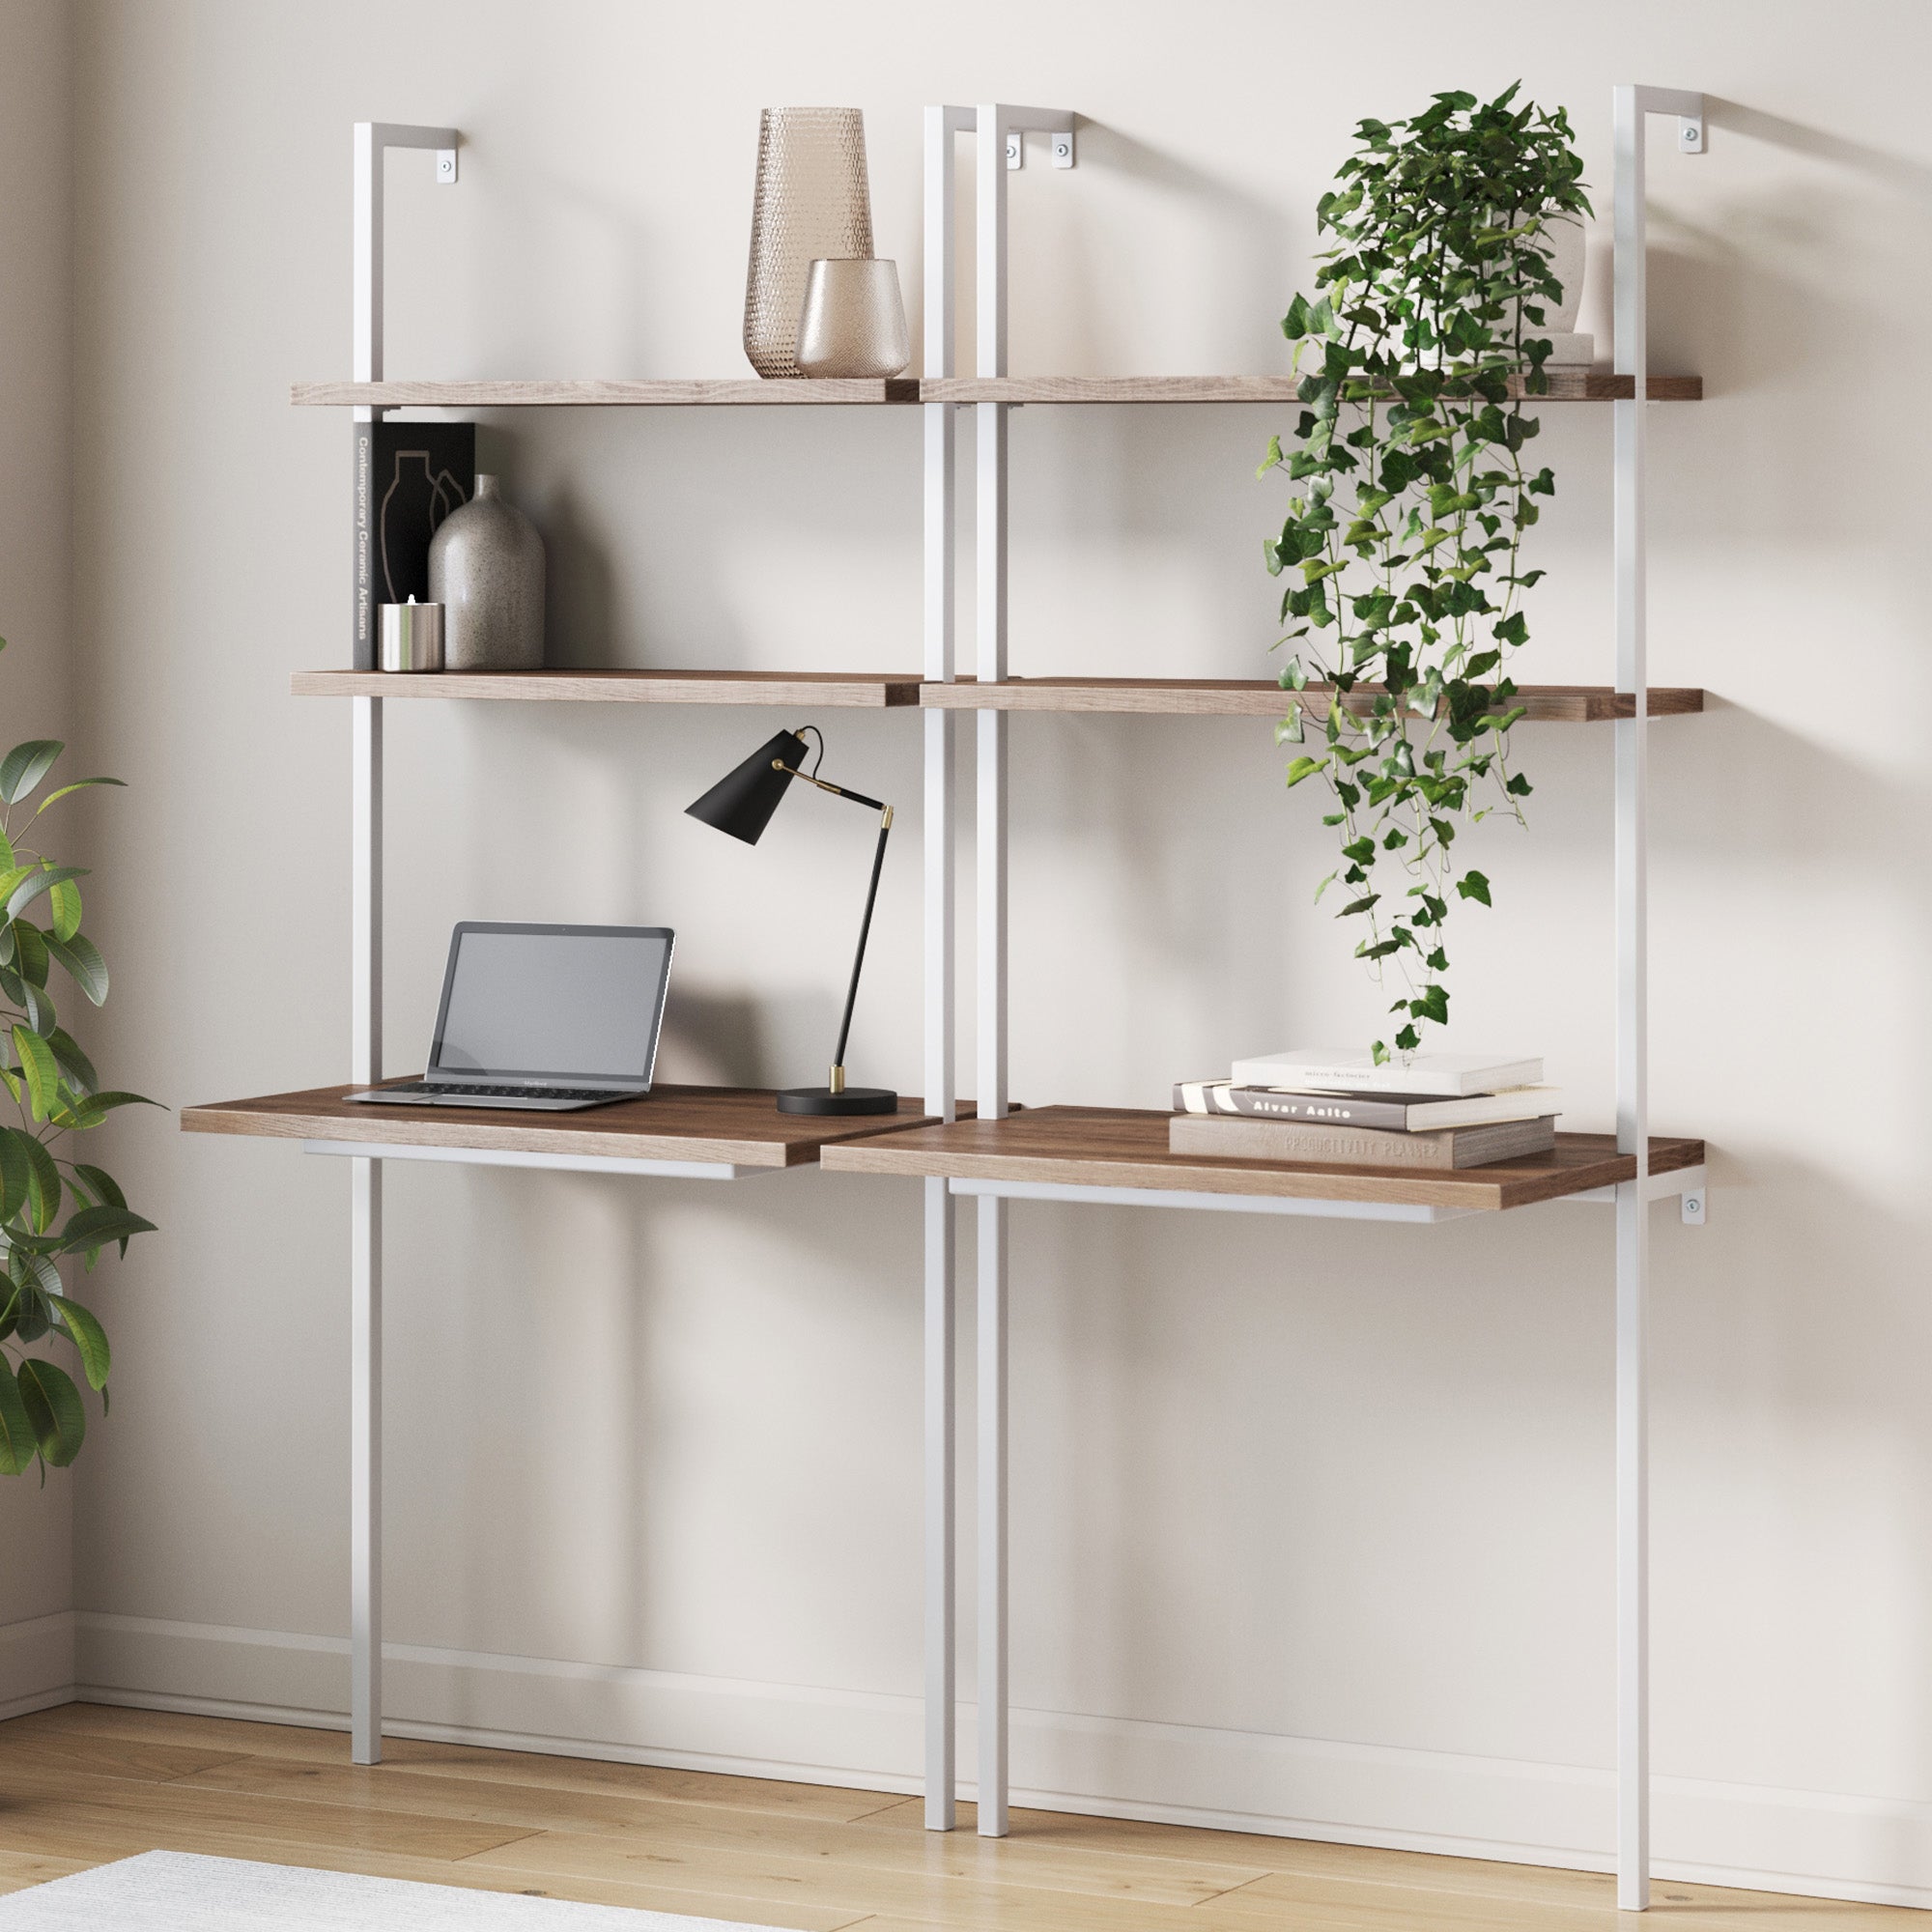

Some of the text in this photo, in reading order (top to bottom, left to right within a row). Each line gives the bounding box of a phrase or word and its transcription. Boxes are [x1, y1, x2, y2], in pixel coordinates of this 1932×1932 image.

[357, 437, 369, 640] Contemporary Ceramic Artisans
[1253, 1100, 1350, 1119] Alvar Aalto
